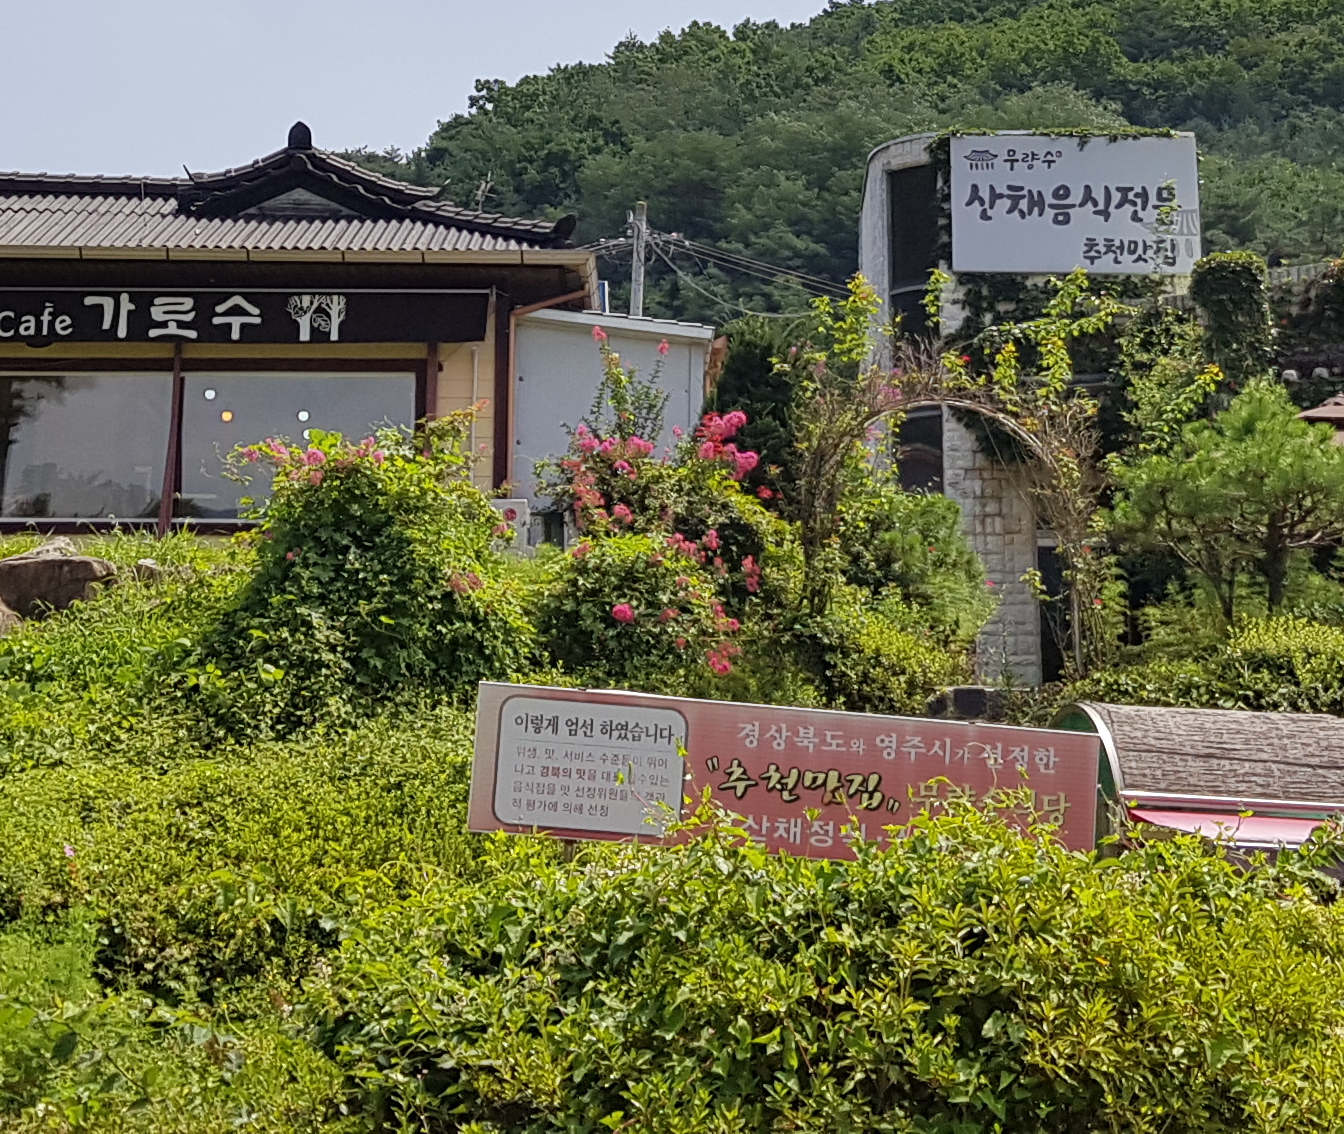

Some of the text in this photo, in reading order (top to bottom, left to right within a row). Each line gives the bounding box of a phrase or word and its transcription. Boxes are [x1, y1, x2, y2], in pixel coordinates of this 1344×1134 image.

[84, 293, 262, 341] 가로수
[514, 713, 675, 746] 이렇게 엄선 하였습니다
